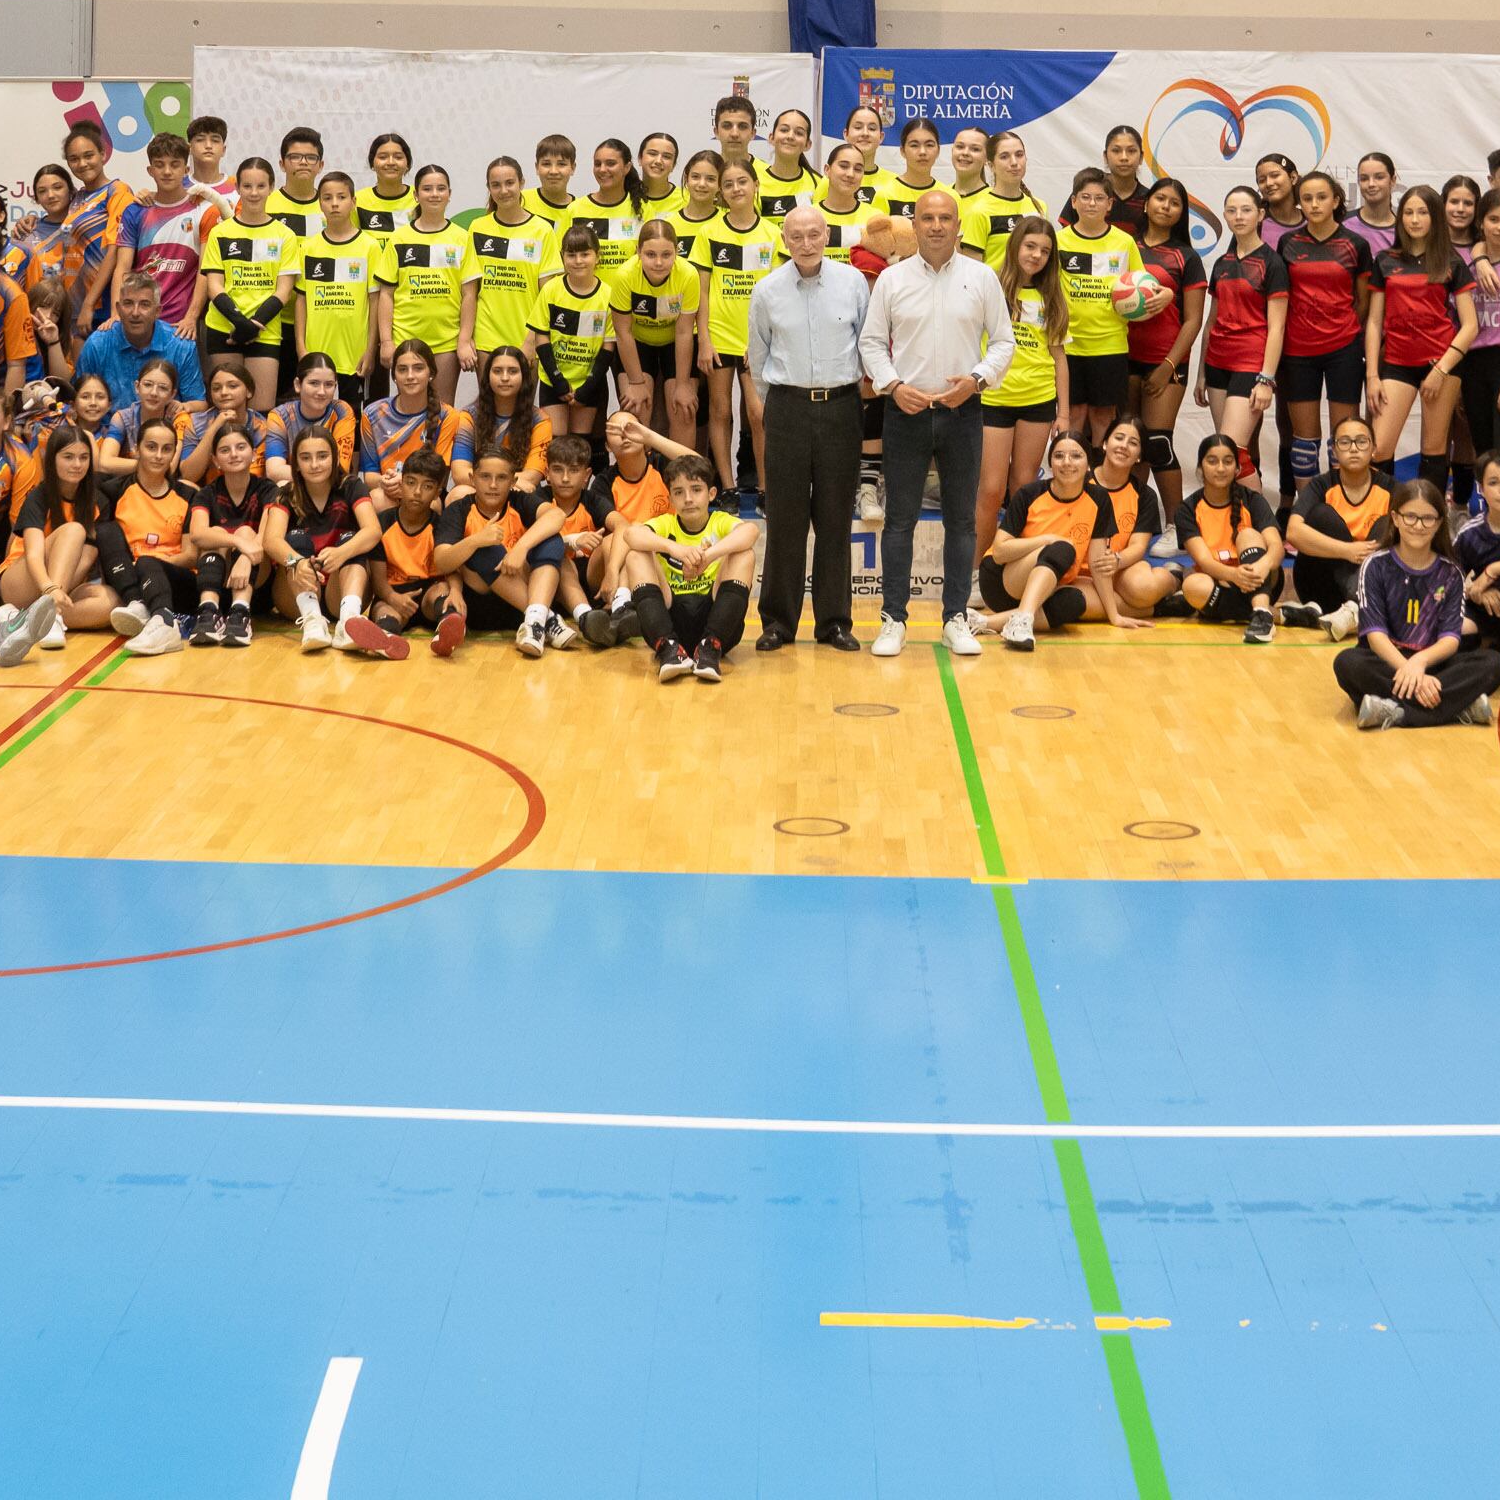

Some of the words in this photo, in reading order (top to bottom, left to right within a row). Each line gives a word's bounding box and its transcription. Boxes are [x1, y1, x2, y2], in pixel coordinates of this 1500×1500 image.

[903, 82, 1013, 100] DIPUTACIÓN
[905, 103, 928, 119] DE
[933, 101, 1012, 119] ALMERÍA
[483, 279, 527, 289] EXCAVACIONES
[1406, 599, 1420, 624] 11
